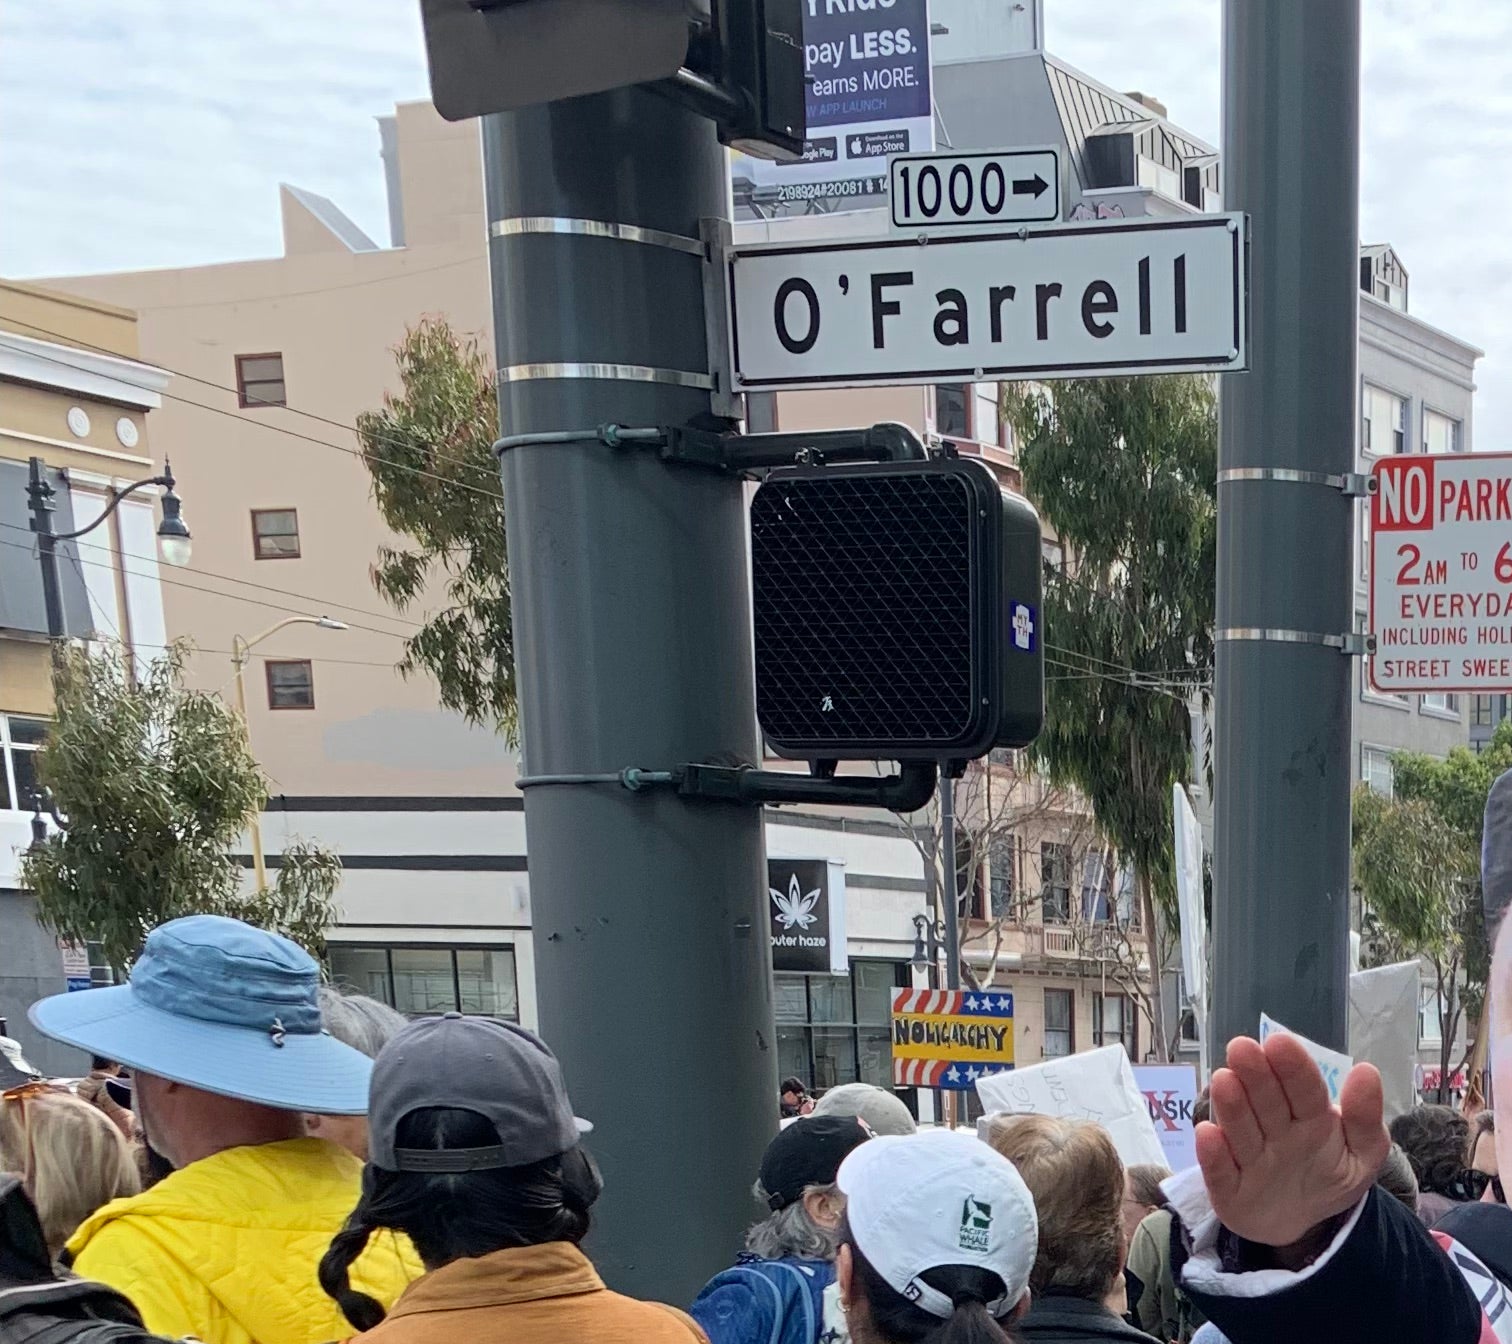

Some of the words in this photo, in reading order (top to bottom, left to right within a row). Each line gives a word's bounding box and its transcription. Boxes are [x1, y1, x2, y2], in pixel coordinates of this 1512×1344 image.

[805, 41, 844, 71] pay
[849, 28, 917, 60] LESS.
[813, 76, 858, 96] earns
[863, 66, 919, 91] MORE.
[820, 104, 840, 115] APP
[843, 98, 888, 113] LAUNCH
[819, 147, 834, 158] Play
[866, 143, 882, 155] App
[882, 141, 905, 152] Store
[900, 162, 1006, 218] 1000
[773, 253, 1187, 355] O'Farrell
[1379, 466, 1428, 525] NO
[1396, 543, 1448, 586] 2AM
[1460, 552, 1478, 570] TO
[1382, 627, 1468, 646] INCLUDING
[1383, 660, 1451, 679] STREET
[798, 933, 827, 947] haze
[893, 1018, 1009, 1051] NOLIGARCHY
[1145, 1099, 1193, 1121] USK
